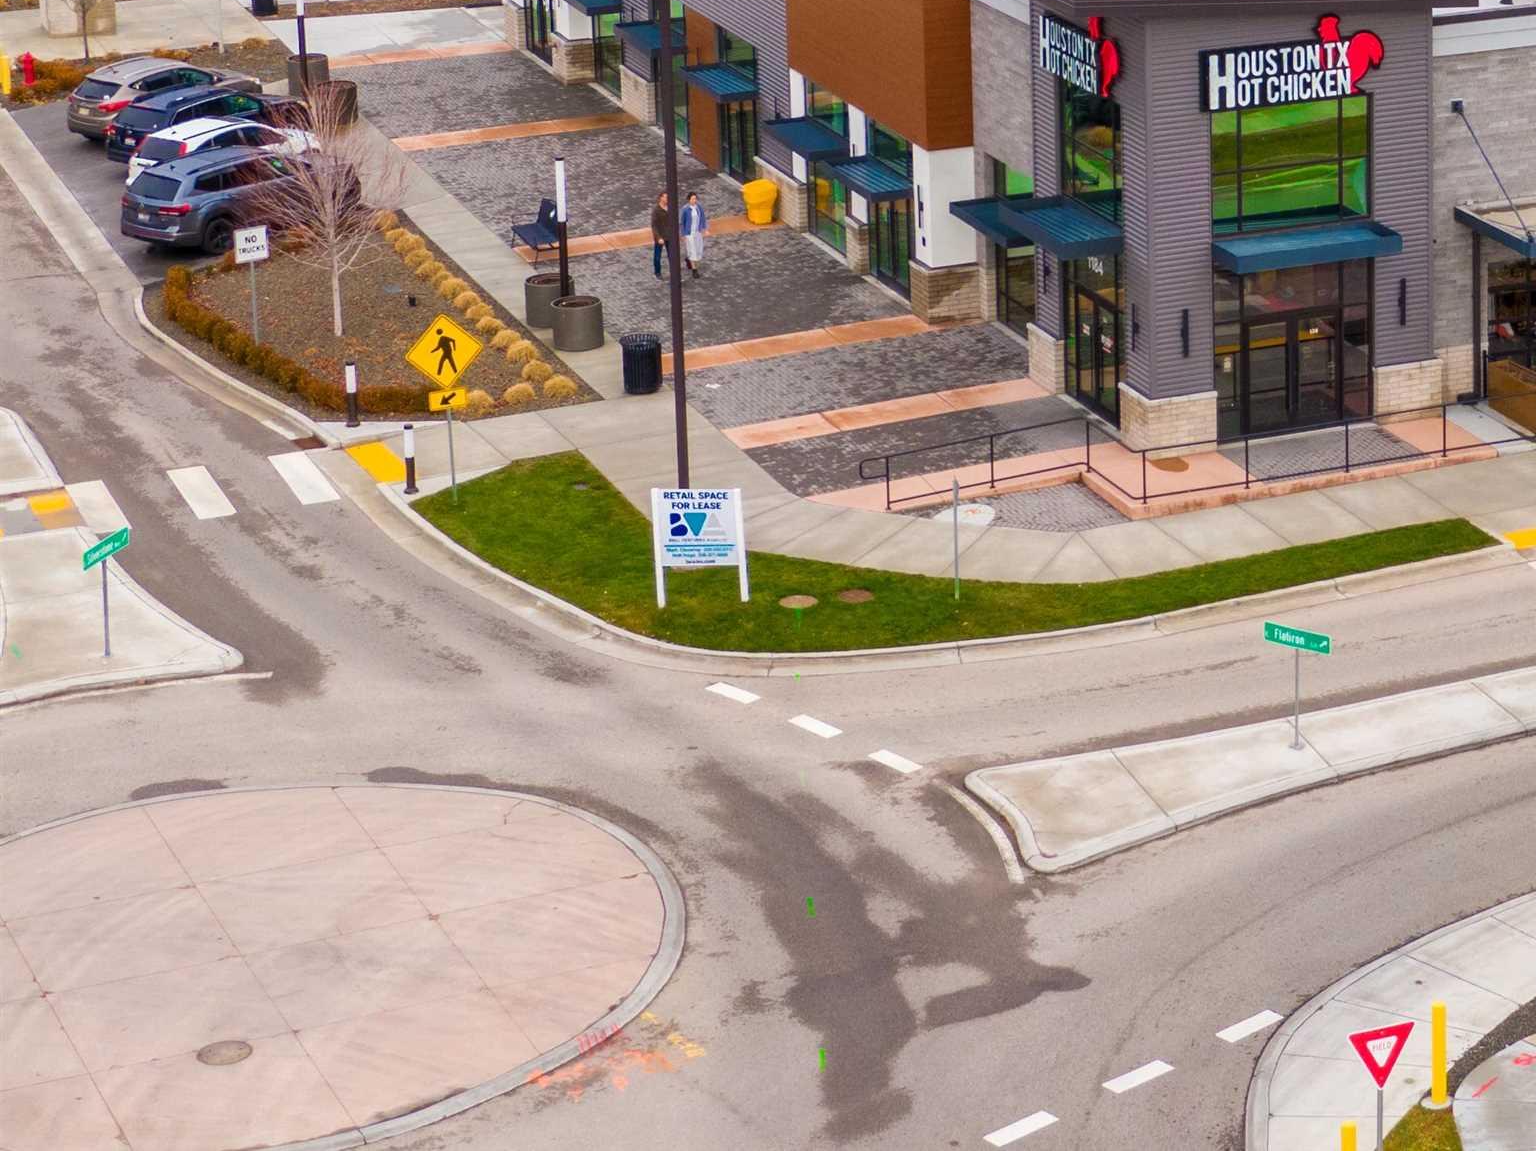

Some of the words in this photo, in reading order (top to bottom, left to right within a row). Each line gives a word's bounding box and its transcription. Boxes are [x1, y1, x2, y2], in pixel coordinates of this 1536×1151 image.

[1085, 38, 1097, 66] TX
[1062, 57, 1098, 94] CHICKEN
[1208, 44, 1321, 110] HOUSTON
[1323, 40, 1351, 70] TX
[1271, 67, 1351, 102] CHICKEN
[244, 235, 257, 243] NO
[698, 491, 728, 499] SPACE
[1371, 1041, 1392, 1052] YIELD
